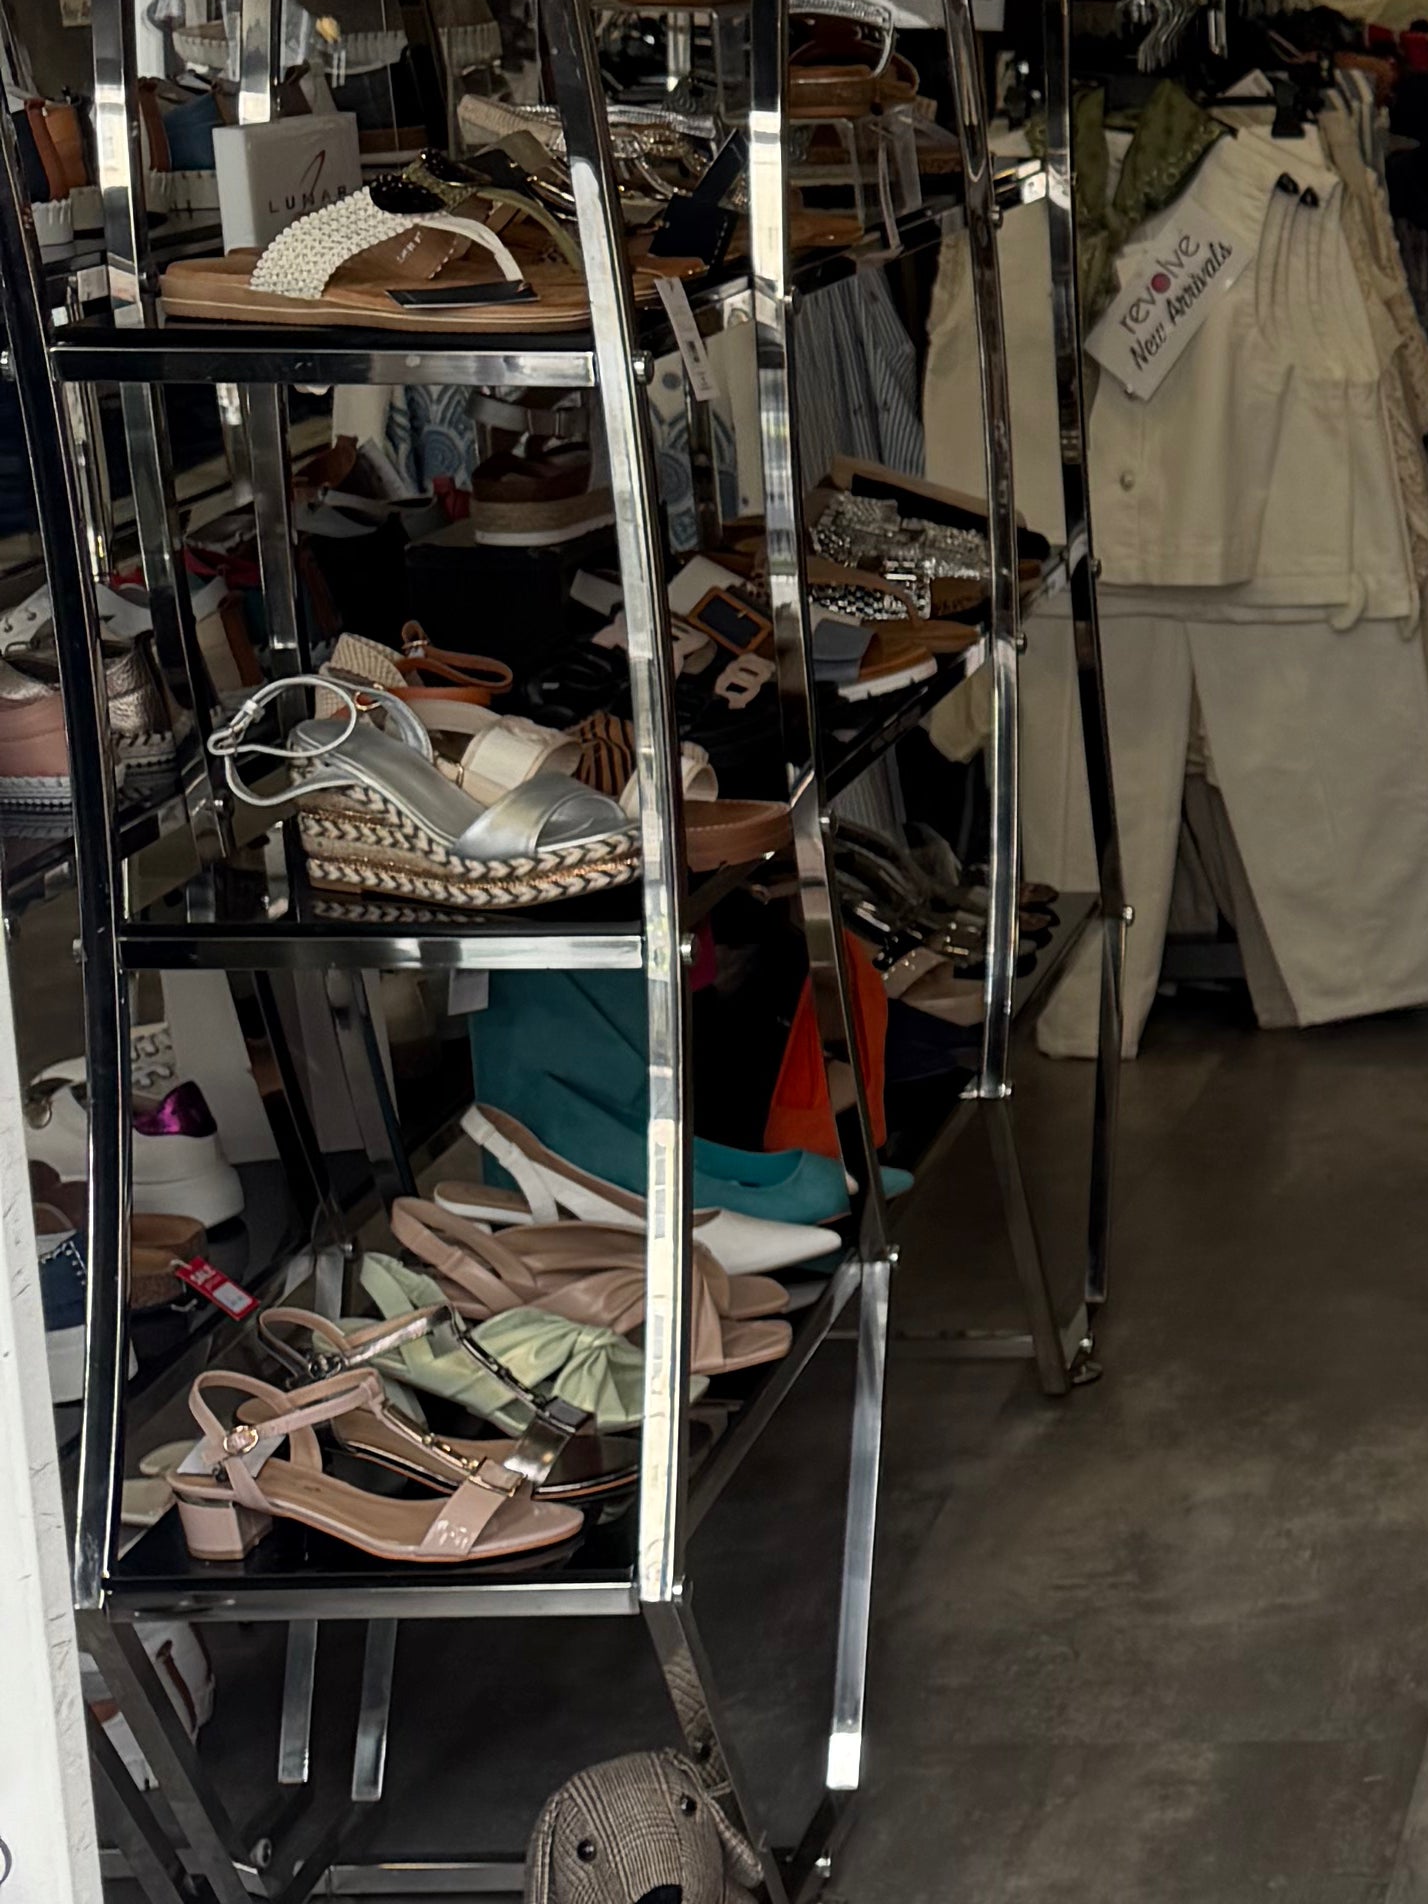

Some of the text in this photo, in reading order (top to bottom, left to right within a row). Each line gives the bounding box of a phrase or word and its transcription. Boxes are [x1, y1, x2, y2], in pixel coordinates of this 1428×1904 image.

[268, 183, 346, 214] LUNAR
[1119, 234, 1201, 335] revolve
[1129, 240, 1233, 372] New Arrivals
